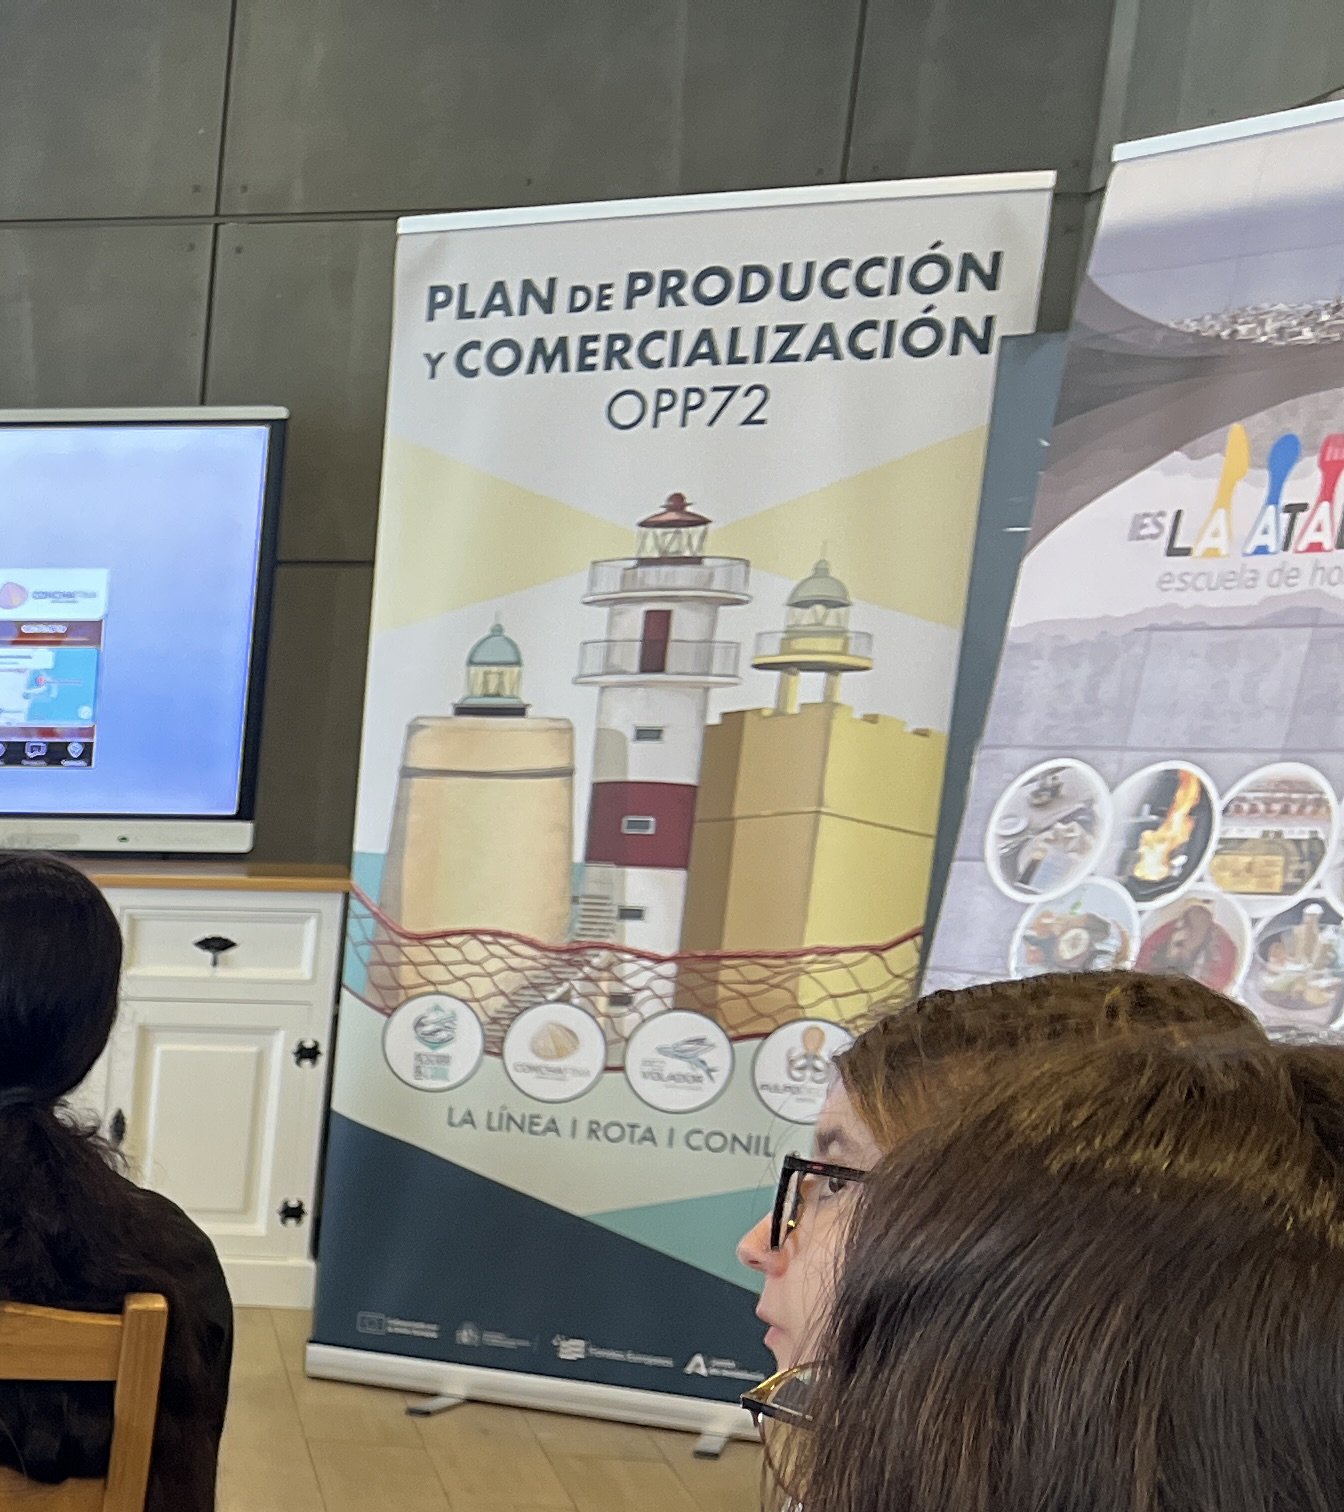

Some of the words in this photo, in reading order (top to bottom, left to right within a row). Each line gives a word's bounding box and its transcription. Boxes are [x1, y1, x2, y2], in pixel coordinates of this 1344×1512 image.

[425, 277, 558, 322] PLAN
[568, 284, 616, 313] DE
[623, 241, 1003, 310] PRODUCCIÓN
[425, 352, 446, 379] Y
[455, 305, 996, 378] COMERCIALIZACIÓN
[607, 384, 769, 431] OPP72
[1166, 509, 1230, 558] LA
[1158, 565, 1259, 592] escuela
[1268, 562, 1299, 588] de
[446, 1106, 477, 1129] LA
[485, 1105, 561, 1138] LÍNEA
[586, 1119, 658, 1147] ROTA
[685, 1128, 776, 1158] CONIL
